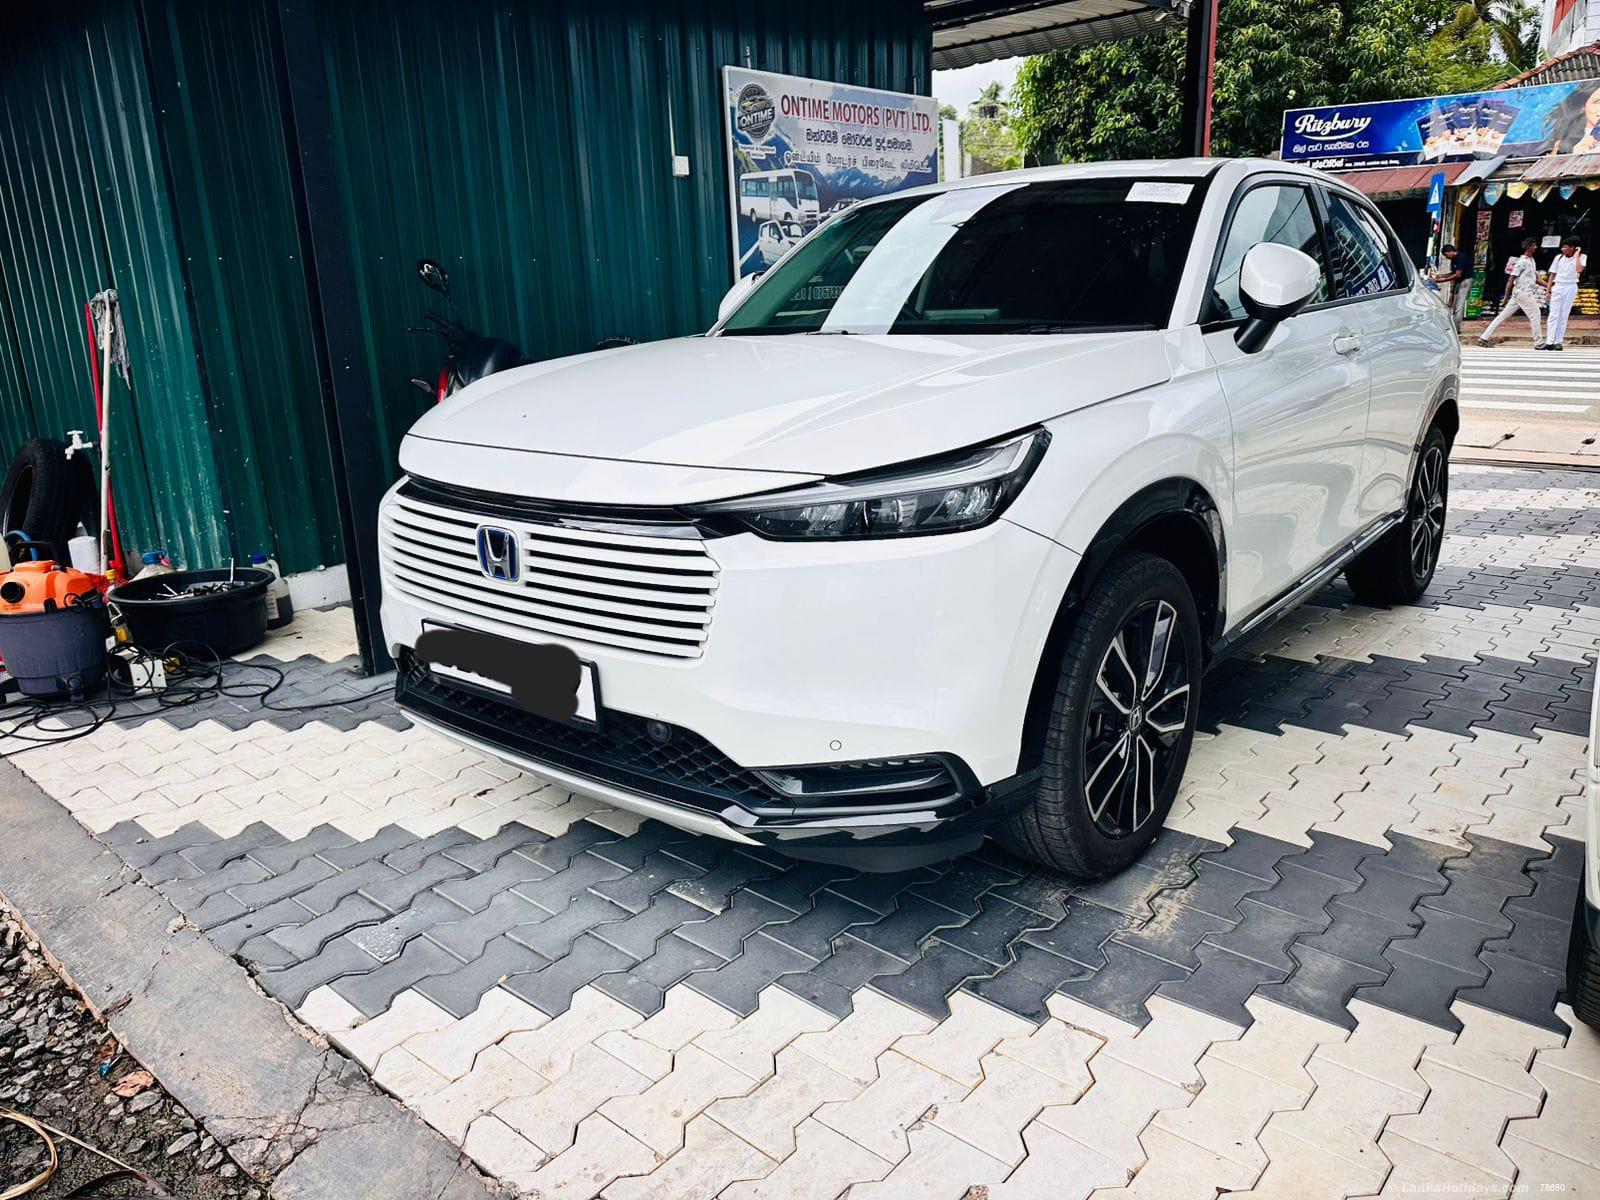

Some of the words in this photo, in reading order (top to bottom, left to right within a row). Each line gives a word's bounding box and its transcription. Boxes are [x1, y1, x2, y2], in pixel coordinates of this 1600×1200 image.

[740, 109, 774, 127] ONTIME
[781, 94, 830, 121] ONTIME
[832, 103, 880, 127] MOTORS
[882, 108, 910, 131] (PVT)
[911, 111, 932, 132] LTD.
[1294, 112, 1372, 139] Ritzbury
